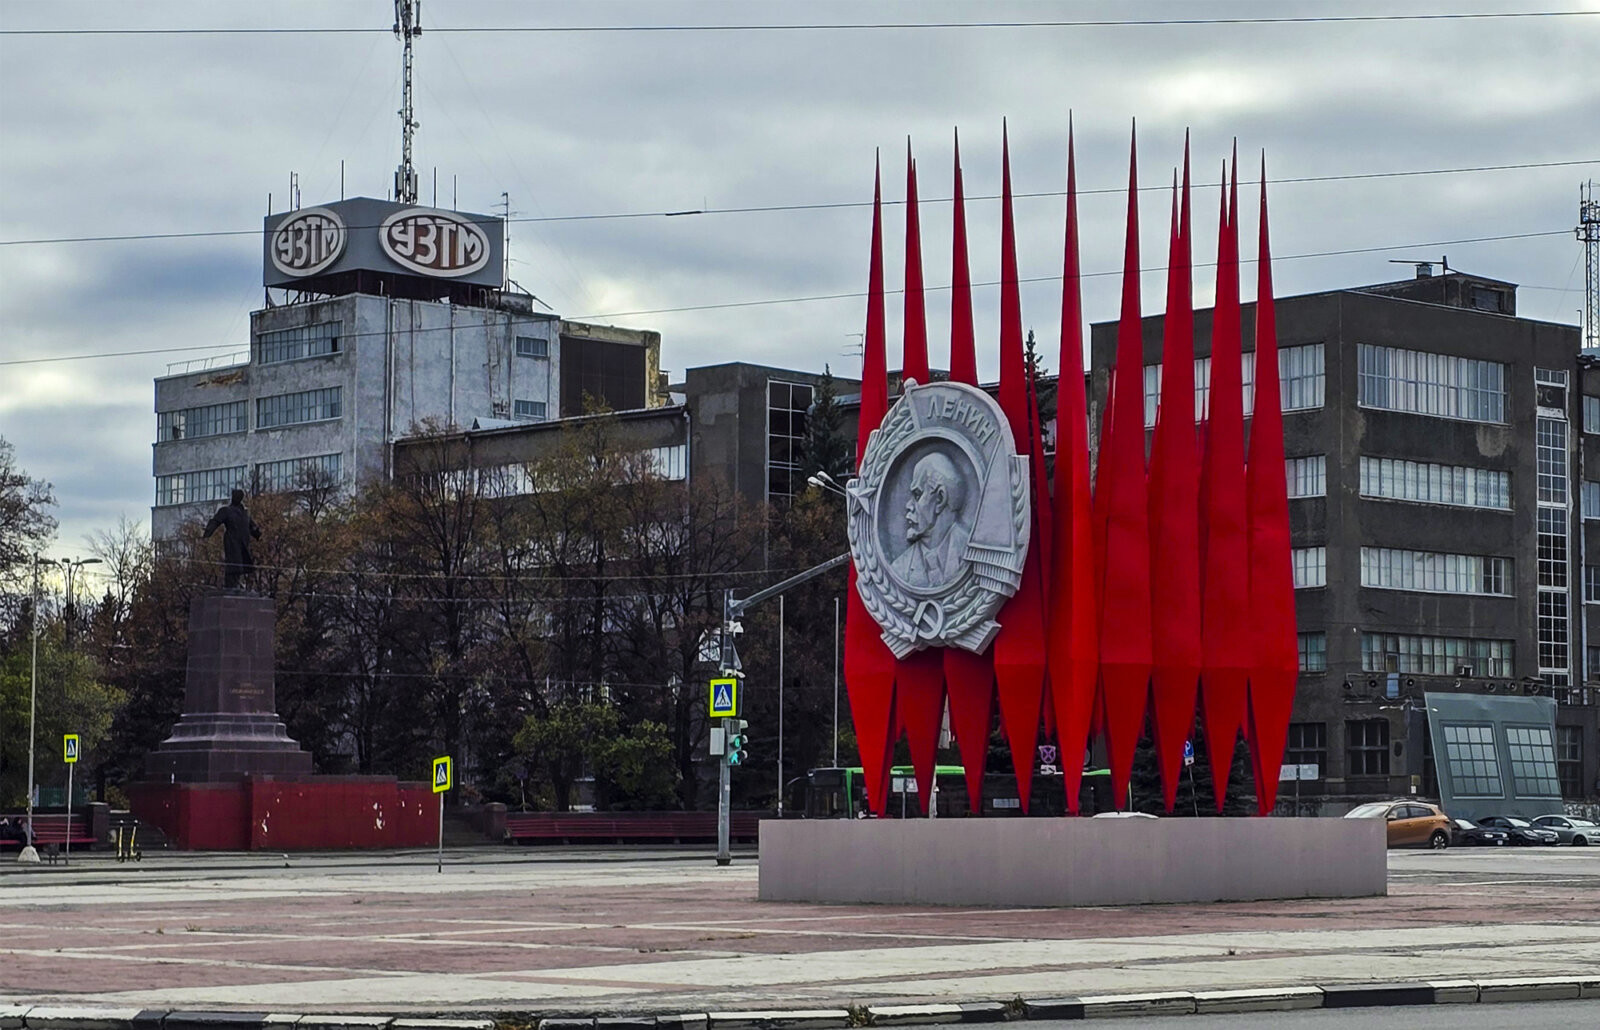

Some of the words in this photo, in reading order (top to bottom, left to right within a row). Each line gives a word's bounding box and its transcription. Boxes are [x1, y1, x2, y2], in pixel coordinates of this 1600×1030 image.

[277, 216, 338, 268] УЗТМ
[391, 217, 482, 268] УЗТМ
[927, 395, 995, 445] ЛЕНИН
